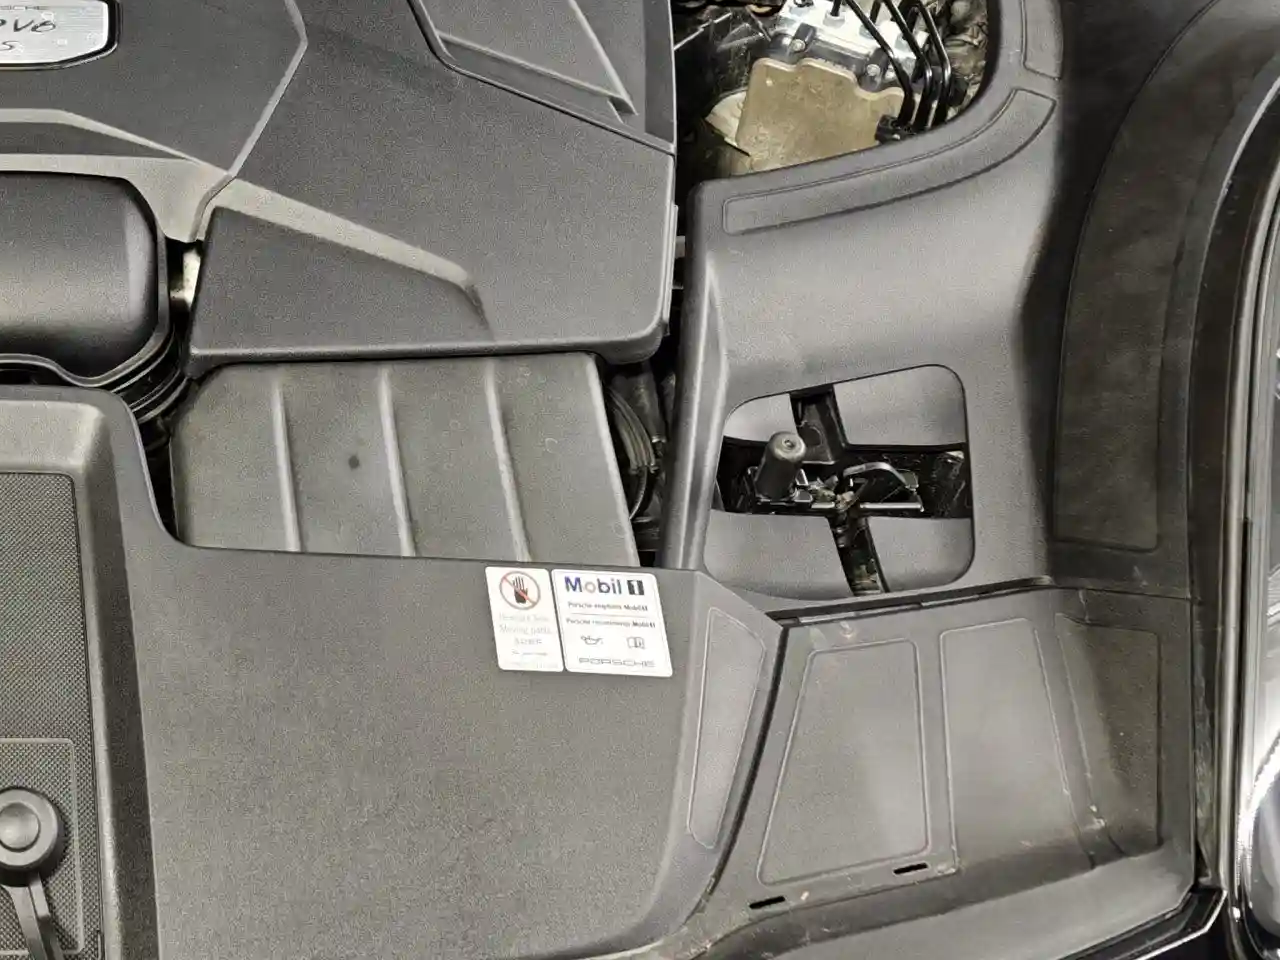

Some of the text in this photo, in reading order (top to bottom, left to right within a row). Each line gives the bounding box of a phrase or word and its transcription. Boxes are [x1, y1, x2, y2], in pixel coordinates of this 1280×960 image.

[564, 576, 644, 596] Mobil 1
[579, 657, 656, 668] PORSCHE
